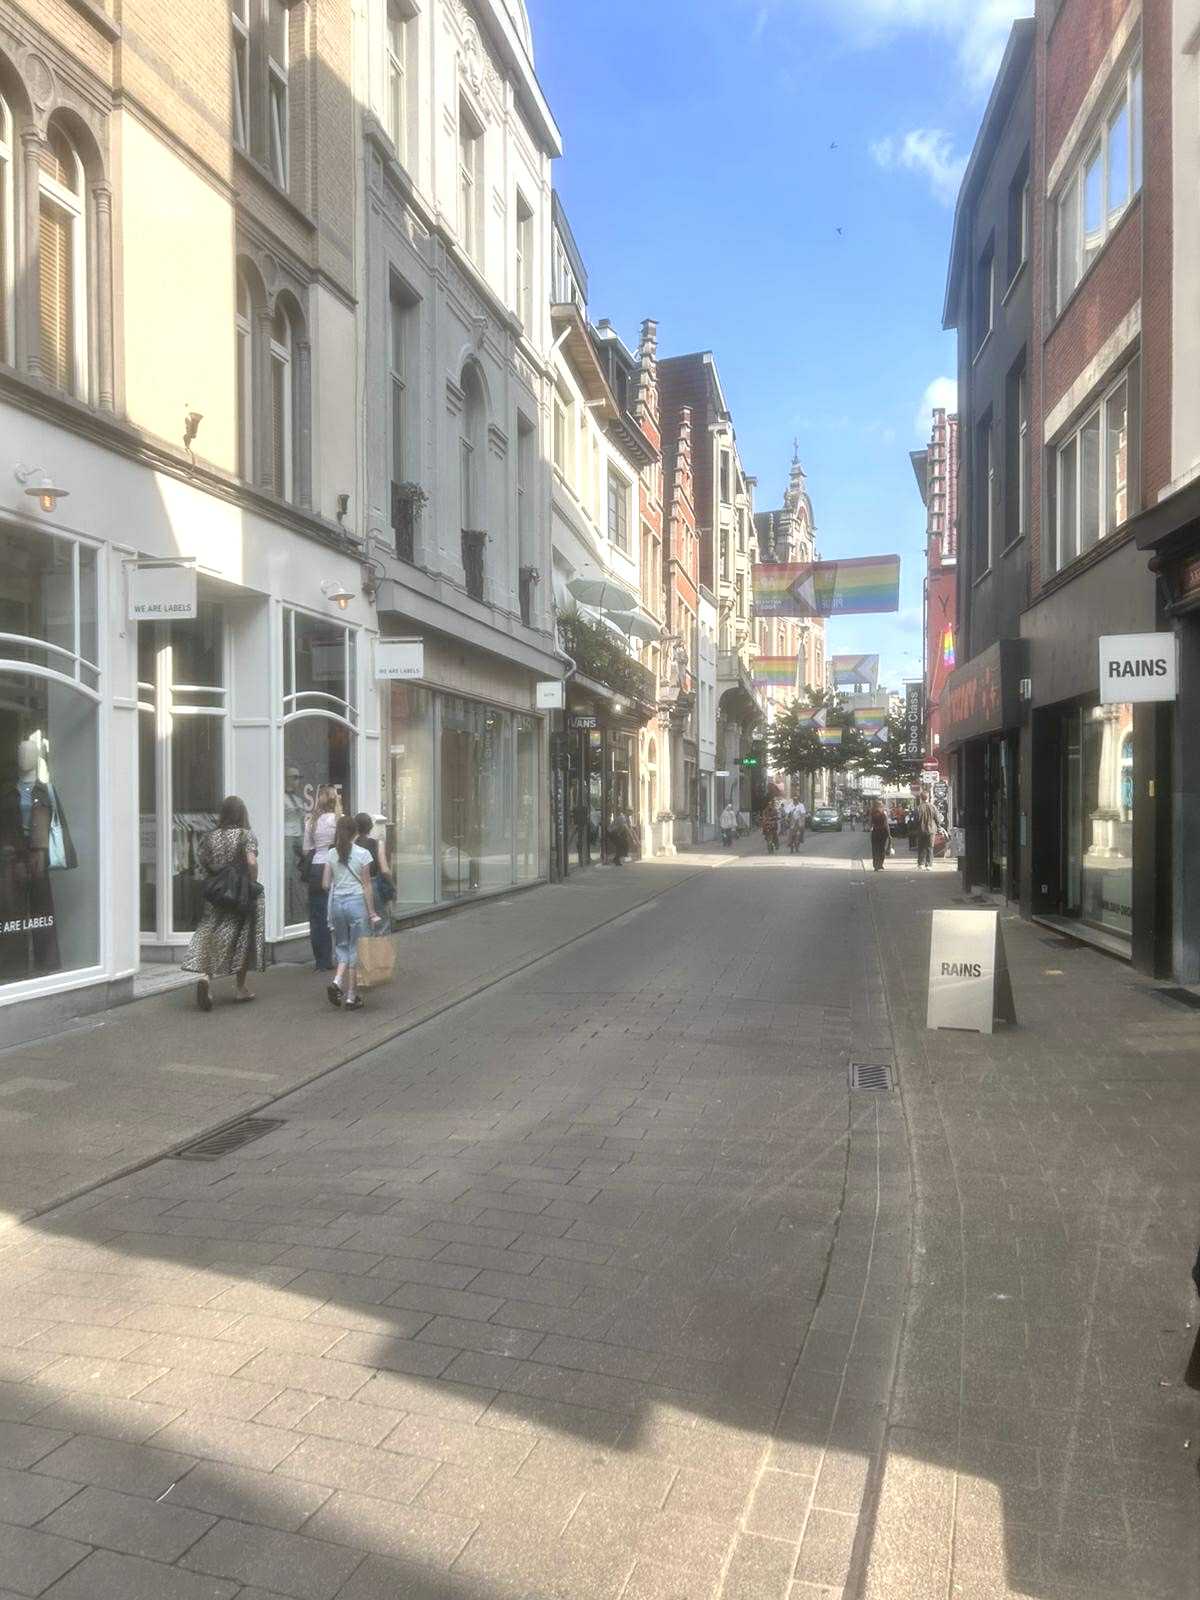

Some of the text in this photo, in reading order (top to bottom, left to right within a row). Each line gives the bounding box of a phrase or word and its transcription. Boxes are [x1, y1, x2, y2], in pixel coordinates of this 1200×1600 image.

[134, 603, 191, 613] WE ARE LABELS
[1109, 659, 1167, 678] RAINS
[572, 716, 597, 728] VANS
[908, 692, 918, 753] Shoe Class
[4, 920, 21, 932] ARE
[23, 915, 54, 929] LABELS
[941, 962, 982, 978] RAINS
